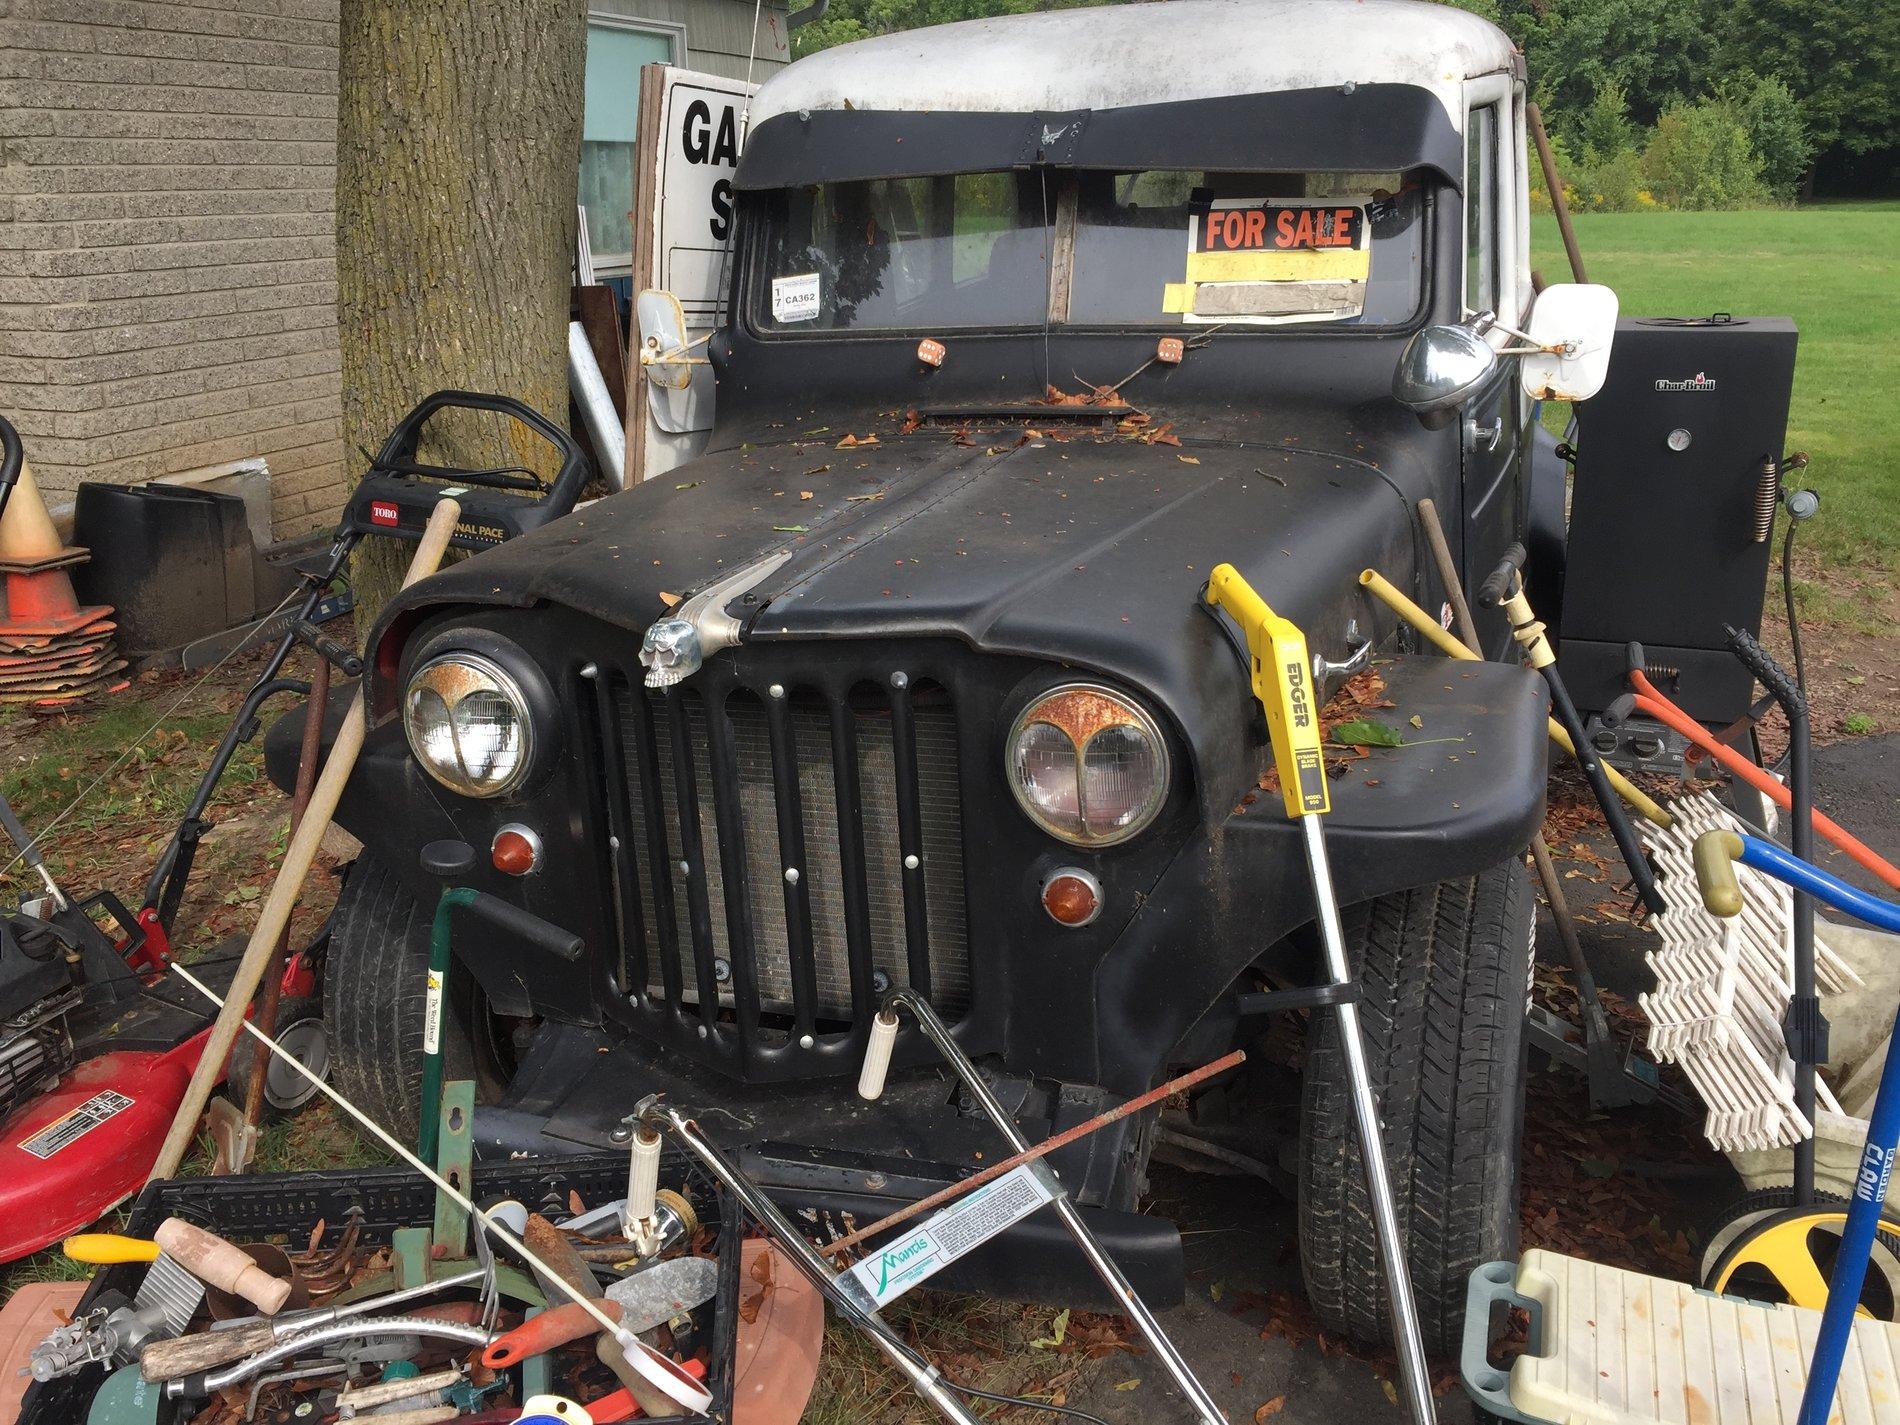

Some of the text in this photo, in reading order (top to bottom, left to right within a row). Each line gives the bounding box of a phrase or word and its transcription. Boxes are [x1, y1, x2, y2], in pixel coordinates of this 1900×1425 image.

[1206, 209, 1354, 249] FOR SALE
[785, 293, 816, 304] CA362
[373, 507, 398, 520] TORO
[480, 525, 504, 539] PACE
[1286, 662, 1310, 728] EDGER
[1857, 1143, 1884, 1202] CLAW
[1877, 1148, 1896, 1202] GARDEN
[876, 1236, 928, 1297] Mantis
